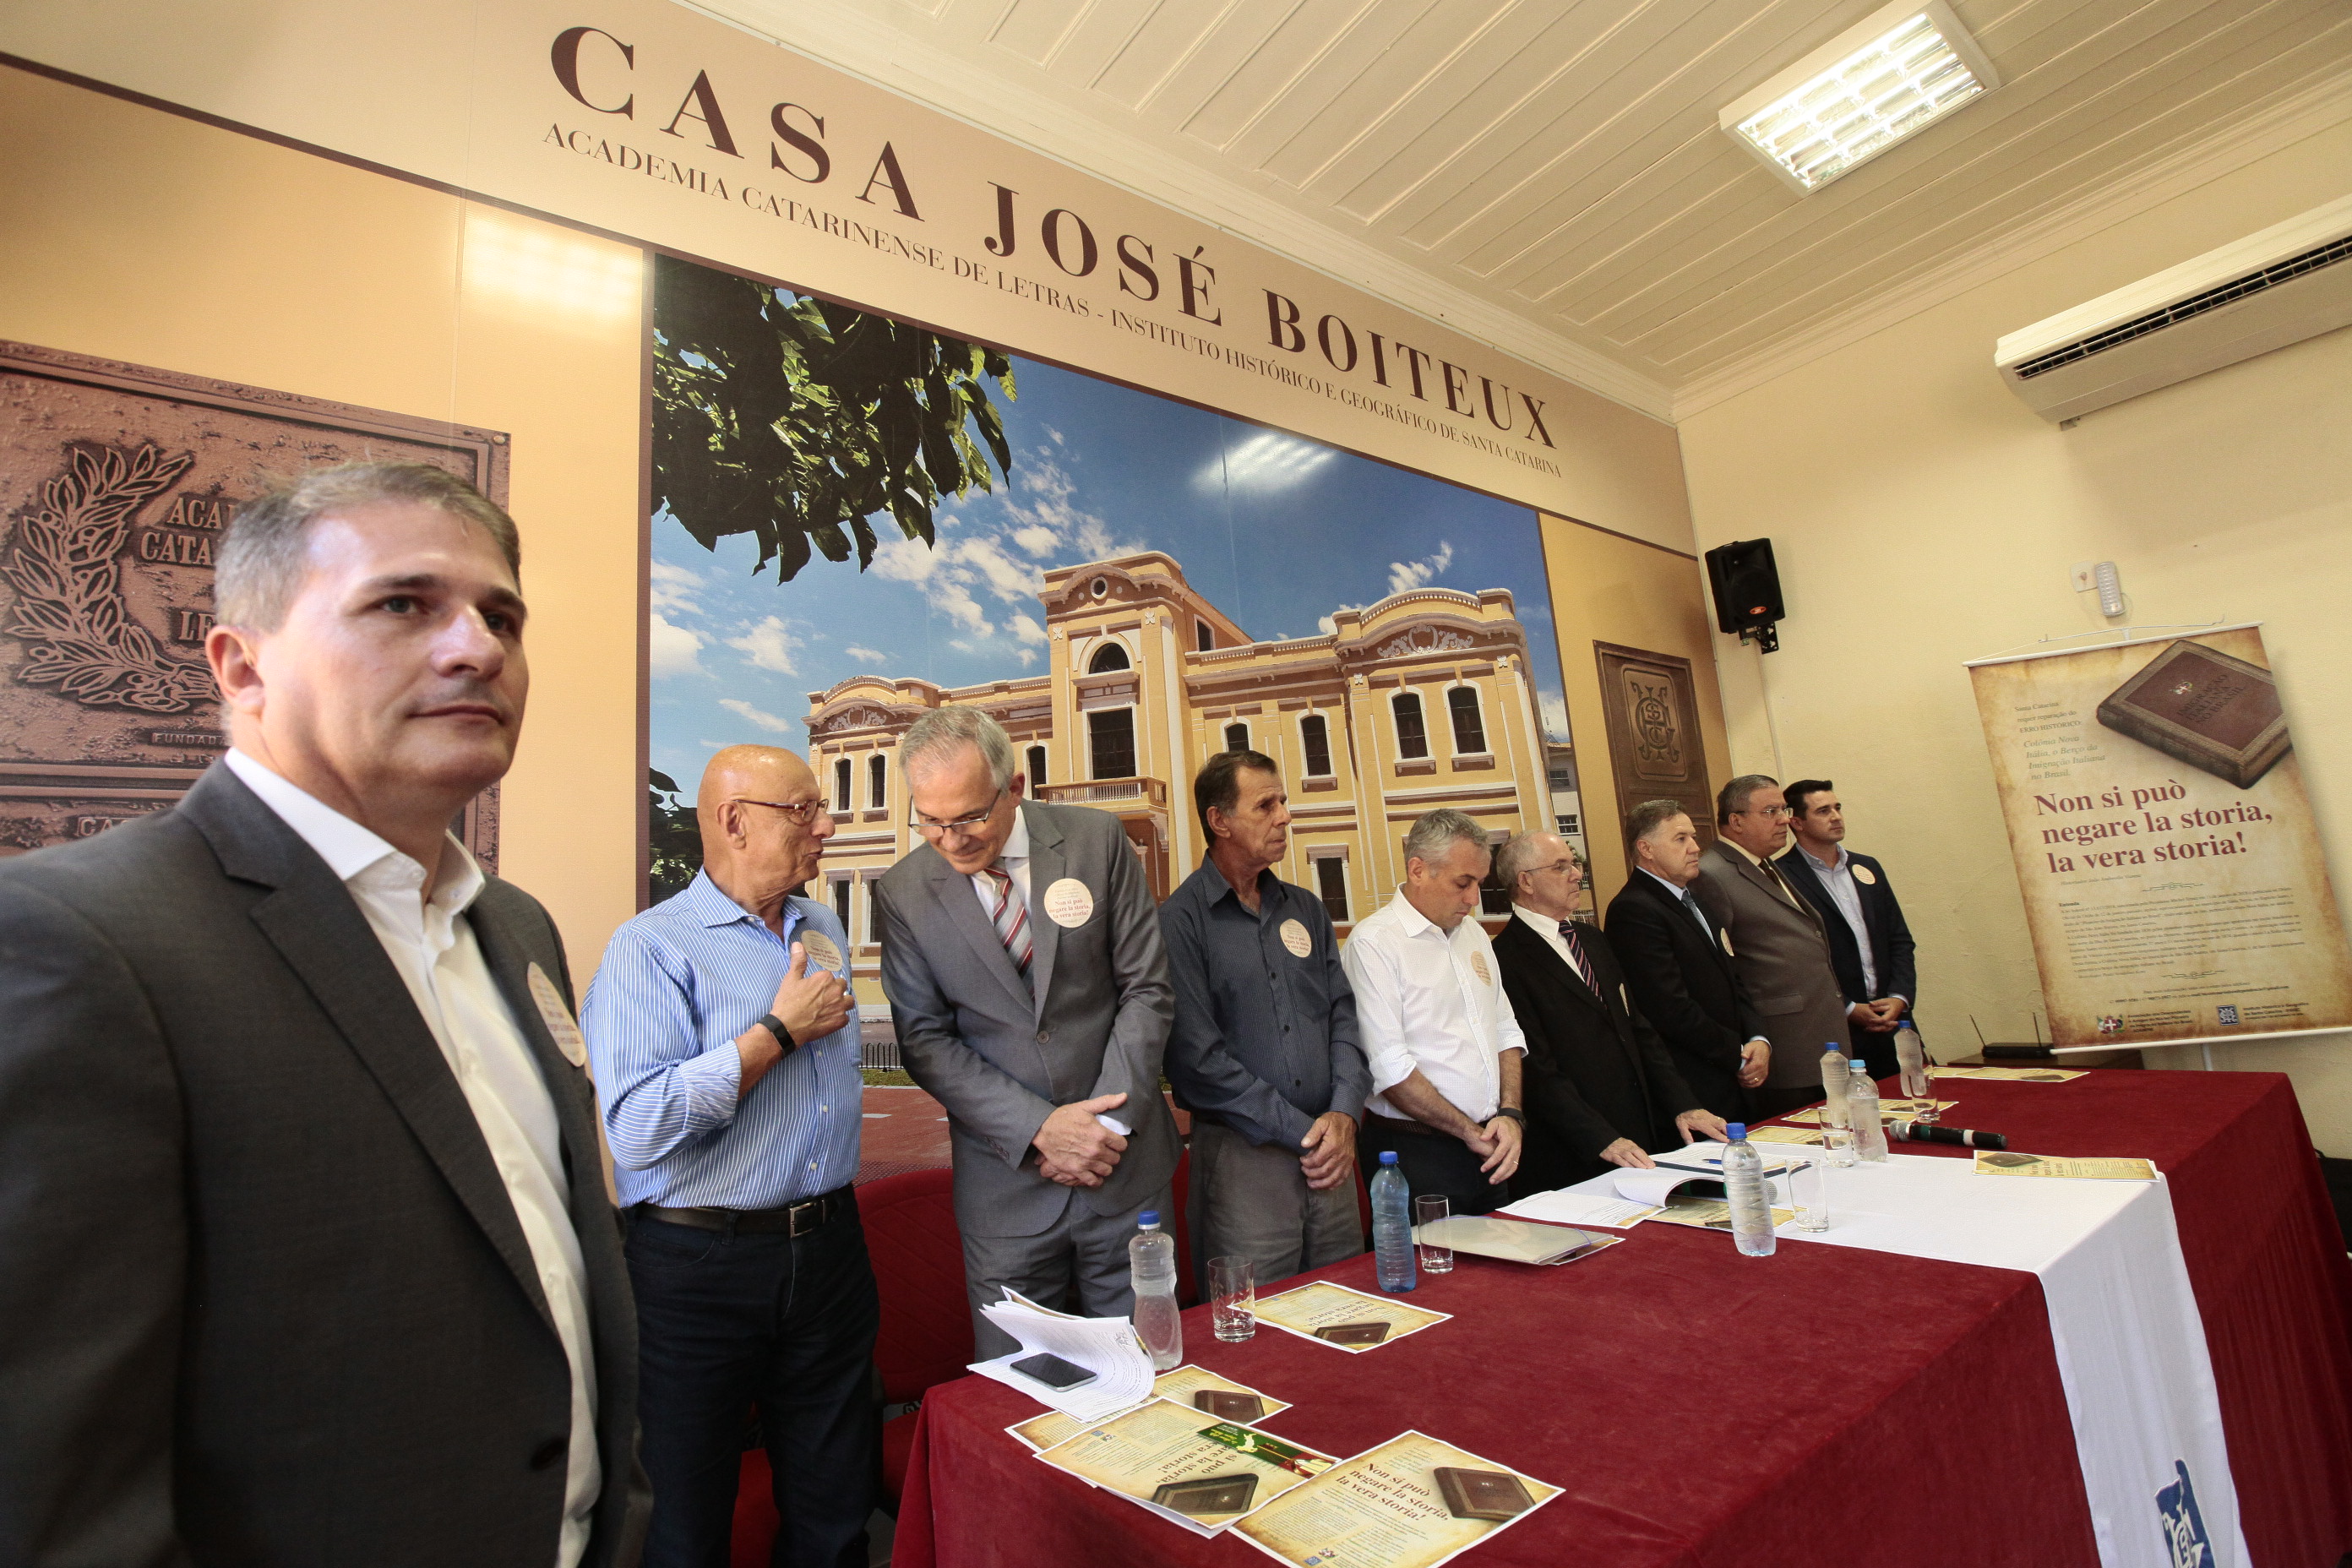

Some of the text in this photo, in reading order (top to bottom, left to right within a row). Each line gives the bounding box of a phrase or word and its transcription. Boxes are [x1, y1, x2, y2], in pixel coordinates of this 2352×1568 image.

[552, 26, 1558, 450] CASA JOSÉ BOITEUX
[542, 122, 732, 202] ACADEMIA
[742, 187, 945, 271] CATARINENSE
[953, 255, 988, 285] DE
[996, 270, 1090, 318] LETRAS
[1111, 308, 1220, 362] INSTITUTO
[1226, 346, 1320, 395] HISTÓRICO
[1326, 383, 1337, 400] E
[1341, 388, 1437, 434] GEOGRÁFICO
[1440, 422, 1459, 443] DE
[1462, 431, 1503, 458] SANTA
[1505, 446, 1562, 478] CATARINA
[141, 531, 214, 566] CATA
[2058, 735, 2080, 744] Nova
[2028, 754, 2106, 770] Imigração Italiana
[2034, 778, 2186, 816] Non si può
[2041, 801, 2273, 847] negare la storia,
[2046, 831, 2247, 874] la vera storia!
[1157, 1451, 1197, 1473] storia!
[1196, 1442, 1217, 1452] era
[1201, 1453, 1237, 1474] si può
[1336, 1475, 1427, 1521] la vera storia!
[1349, 1470, 1449, 1521] negare la storia,
[1363, 1463, 1430, 1497] Non si può
